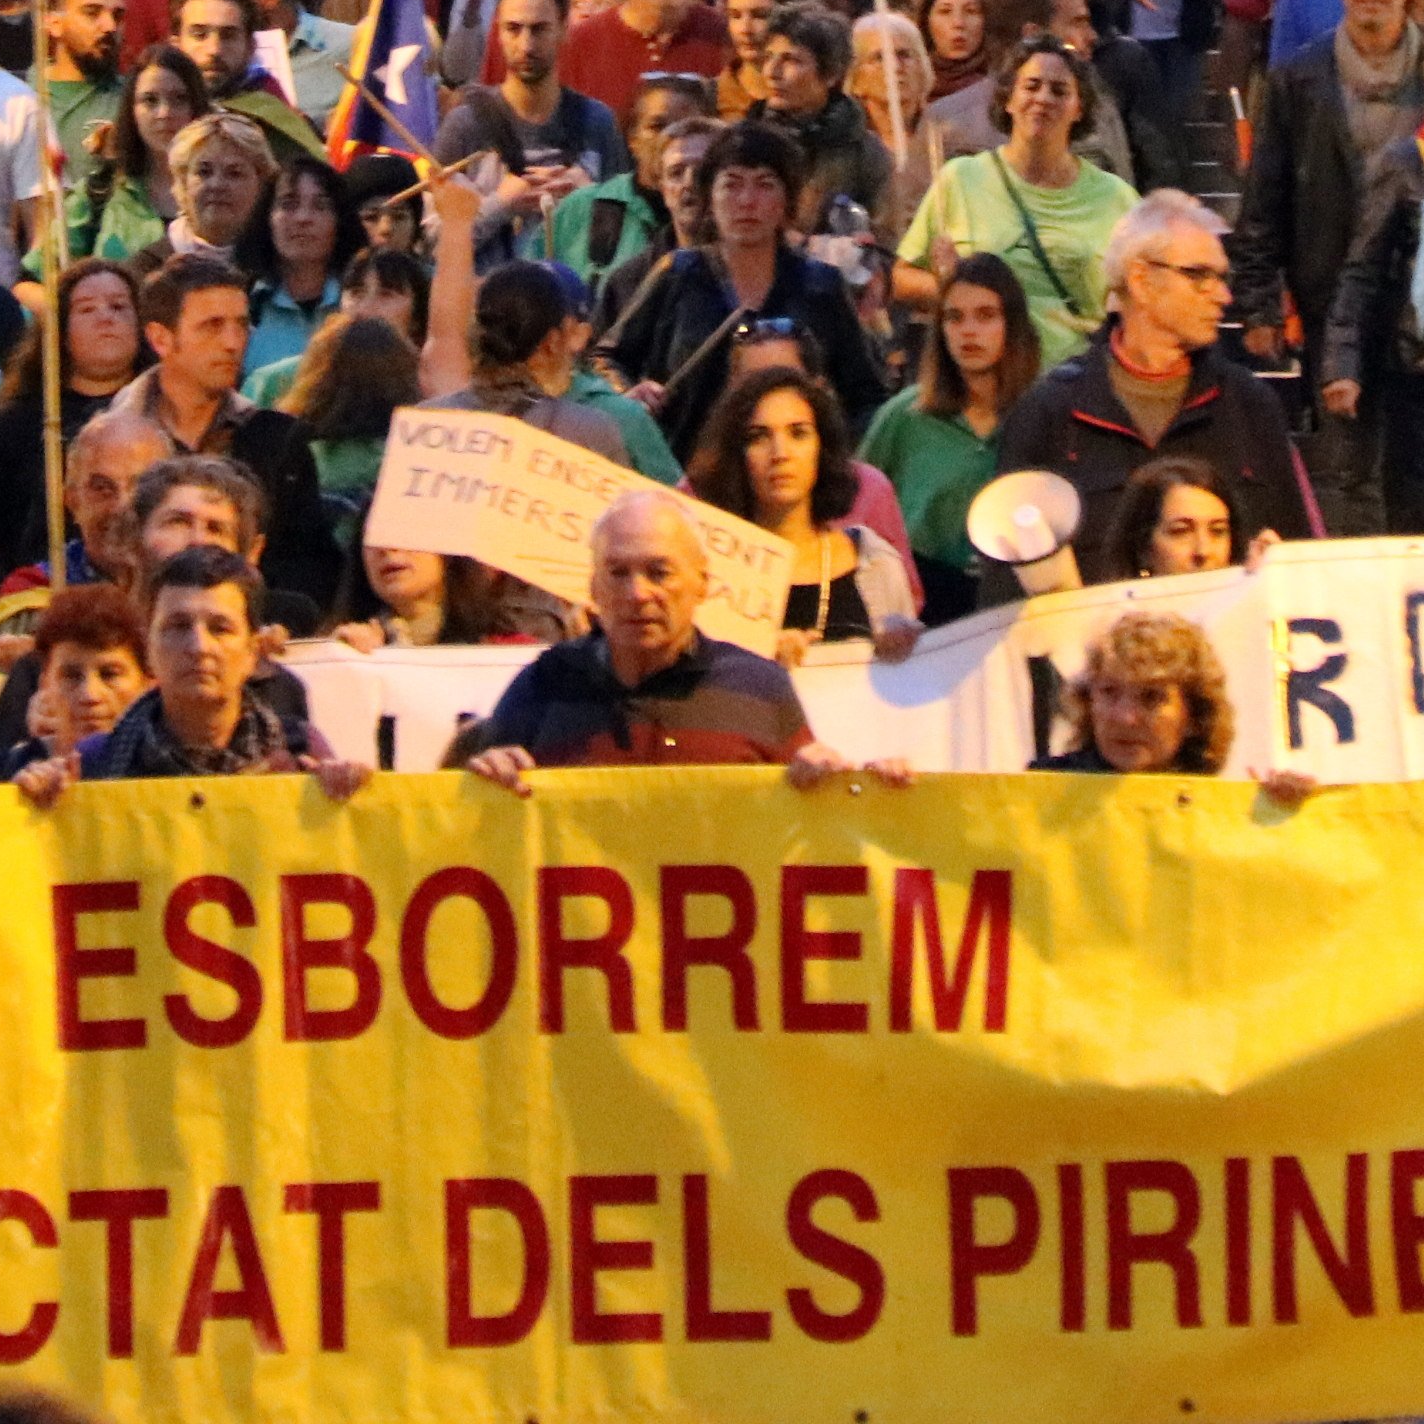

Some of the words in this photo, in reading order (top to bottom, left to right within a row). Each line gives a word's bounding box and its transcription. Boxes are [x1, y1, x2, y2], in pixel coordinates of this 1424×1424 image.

[399, 419, 513, 463] VOLEM
[402, 466, 584, 543] IMMERS
[51, 863, 1014, 1052] ESBORREM
[443, 1168, 885, 1349] DELS
